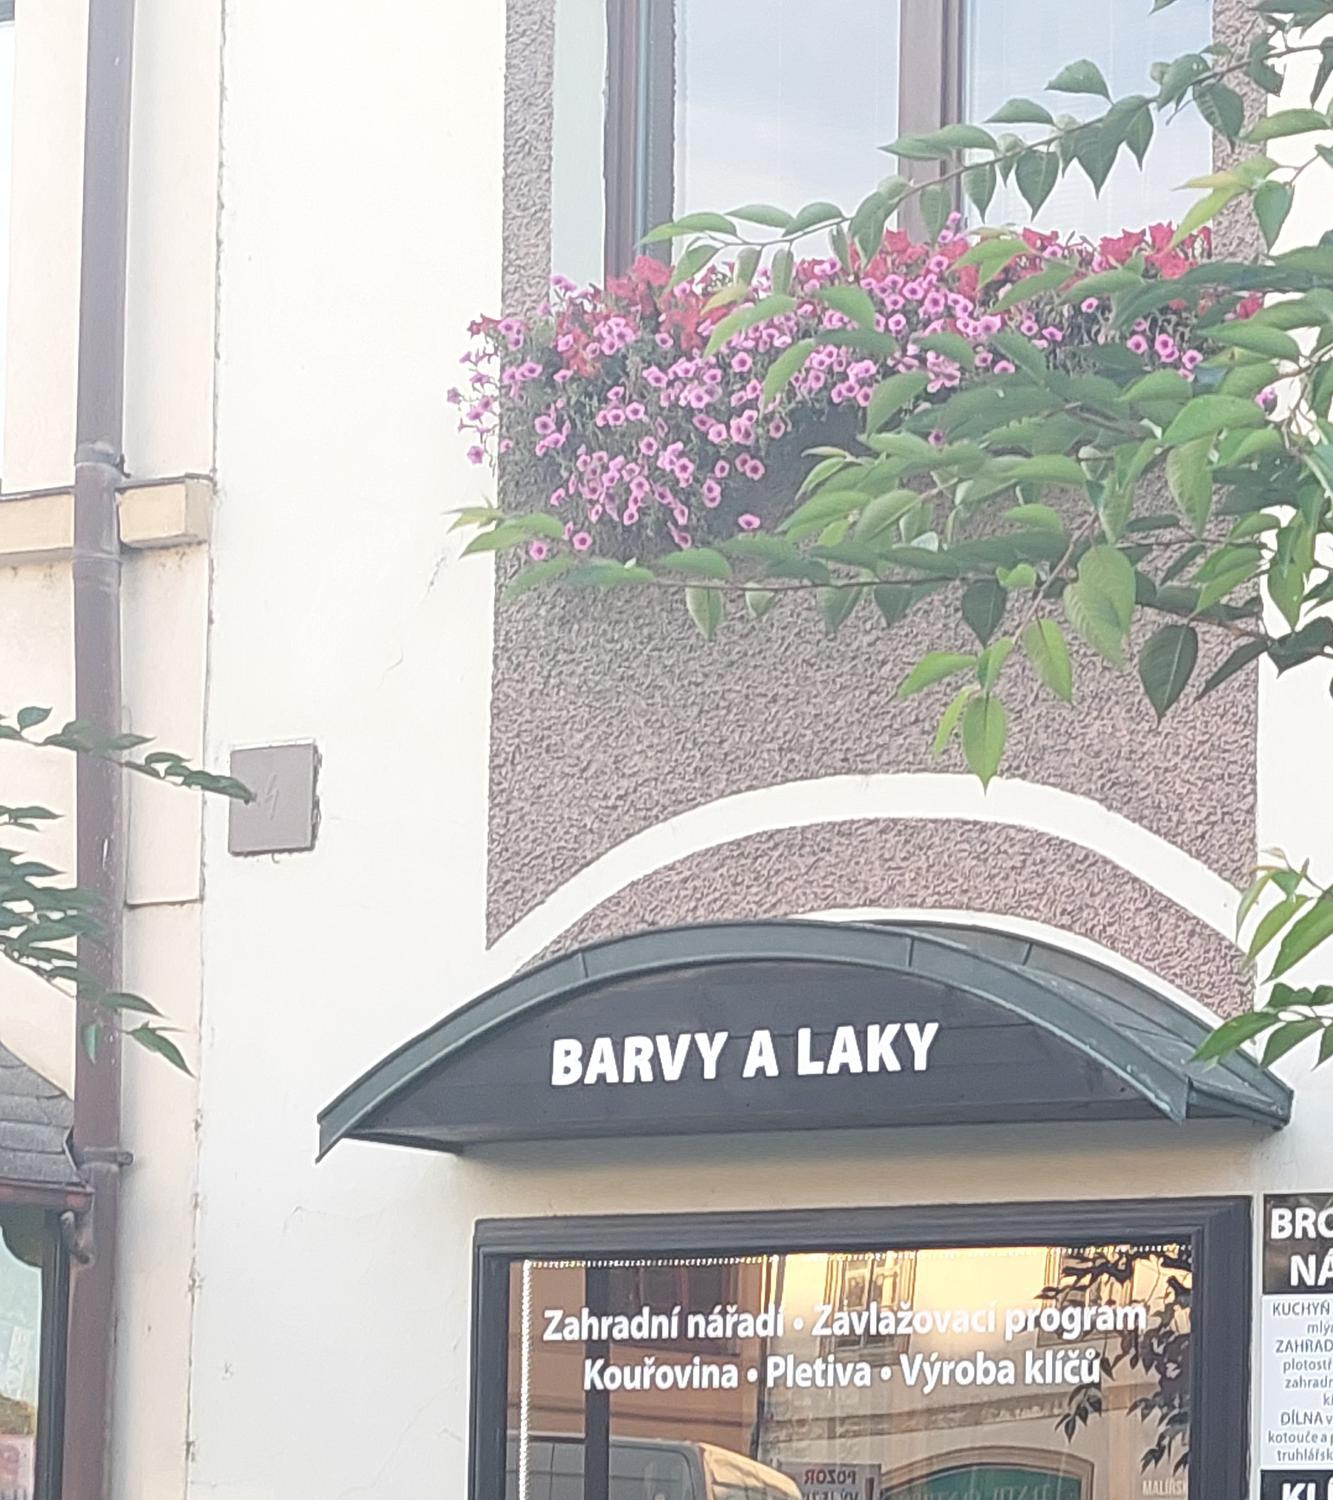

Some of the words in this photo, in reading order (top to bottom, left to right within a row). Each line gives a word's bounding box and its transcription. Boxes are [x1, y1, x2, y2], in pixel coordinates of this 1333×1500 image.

[552, 1032, 728, 1086] BARVY
[741, 1030, 779, 1078] A
[797, 1022, 939, 1076] LAKY
[543, 1304, 679, 1342] Zahradní
[687, 1304, 784, 1339] nářadí
[812, 1300, 996, 1338] Zavlažovací
[1004, 1302, 1147, 1339] program
[1273, 1301, 1330, 1316] KUCHYŇ
[583, 1354, 739, 1392] Kouřovina
[766, 1353, 872, 1390] Pletiva
[899, 1353, 1016, 1394] Výroba
[1024, 1348, 1101, 1385] klíčů
[1281, 1409, 1323, 1425] DÍLNA
[1268, 1431, 1318, 1444] kotouče
[1321, 1434, 1327, 1443] a
